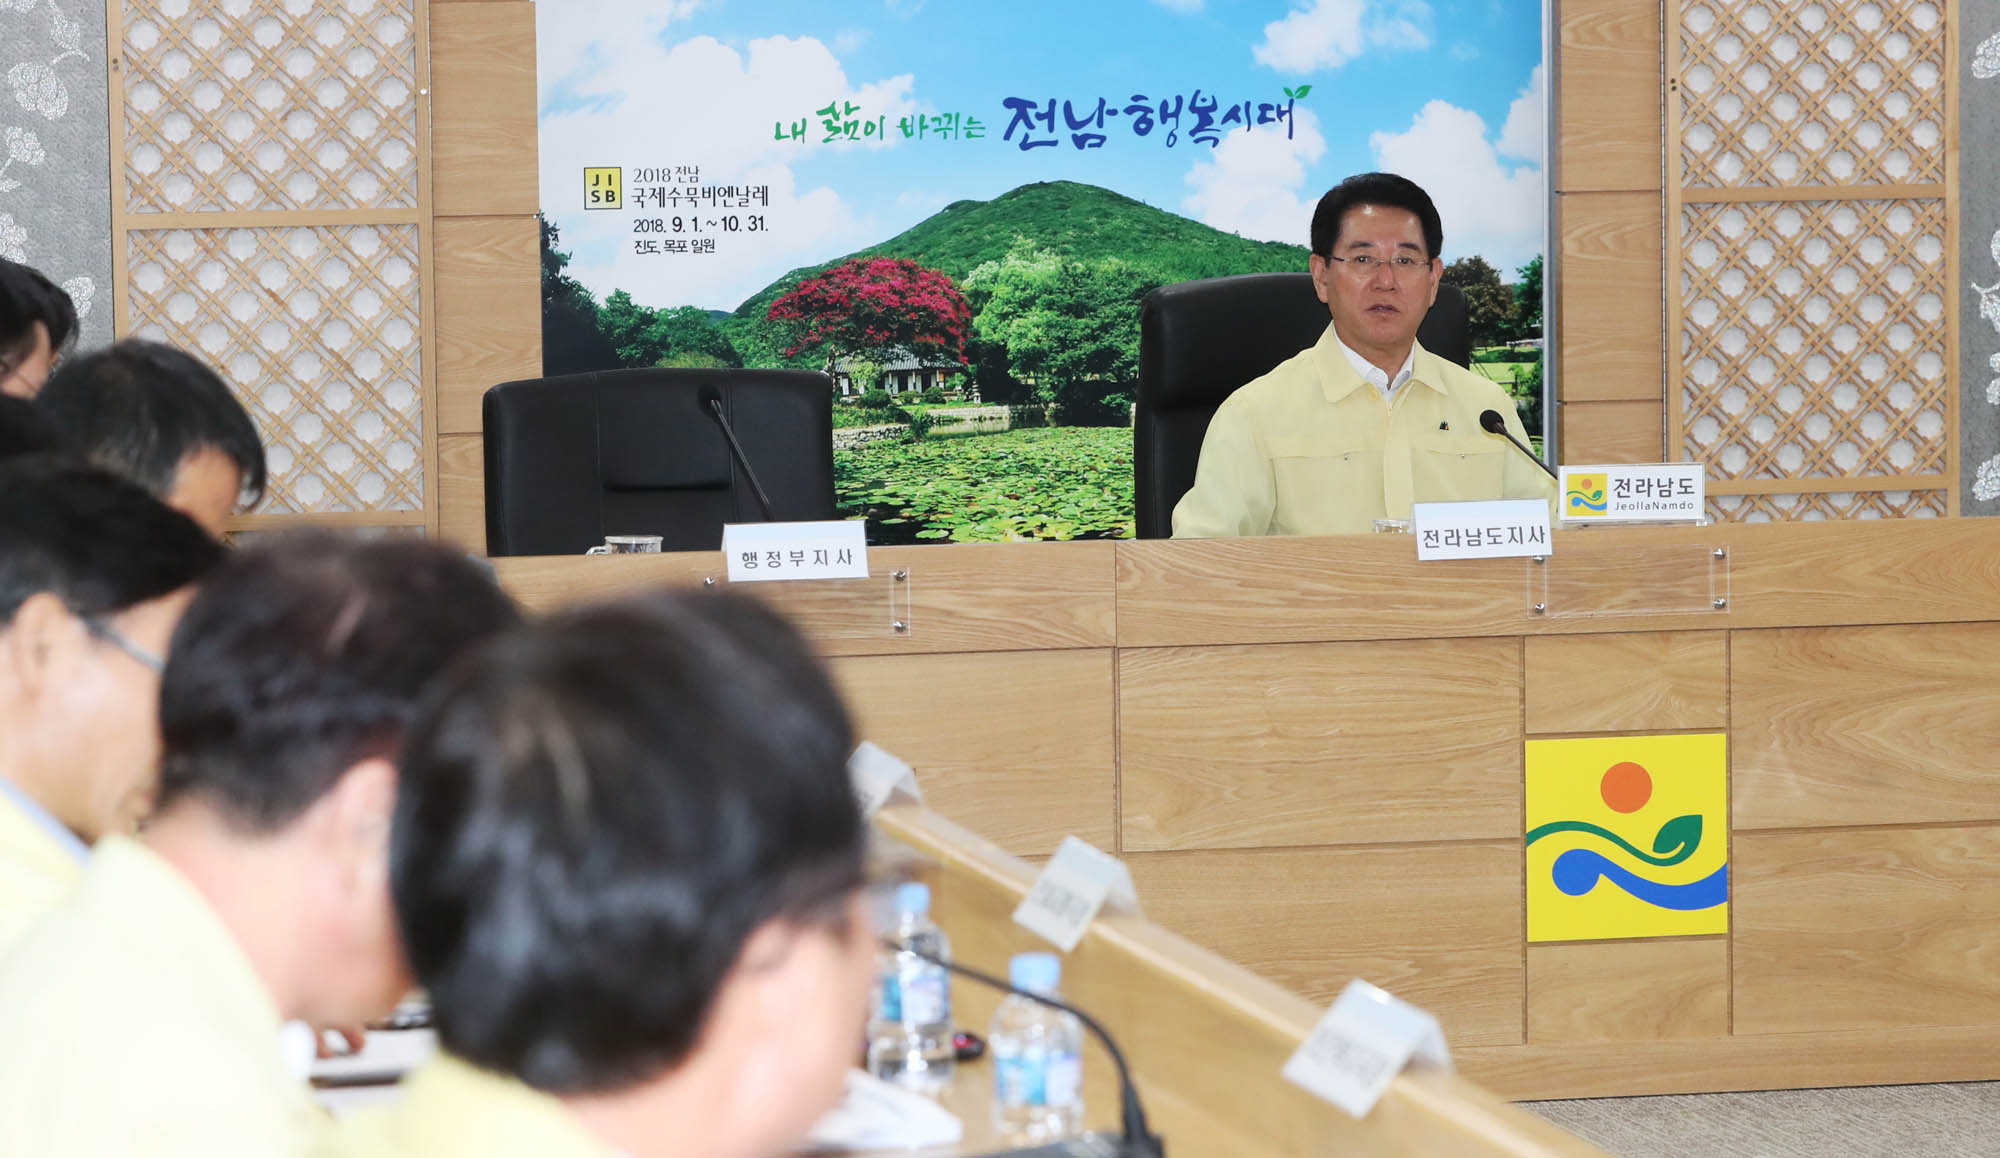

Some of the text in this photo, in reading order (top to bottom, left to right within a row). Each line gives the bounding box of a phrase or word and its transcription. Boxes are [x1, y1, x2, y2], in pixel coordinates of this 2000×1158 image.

[774, 117, 807, 145] 내
[896, 111, 987, 141] 바뀌는
[1002, 96, 1119, 151] 전남
[633, 165, 700, 183] 2018 전남
[631, 185, 769, 208] 국제수묵비엔날레
[633, 218, 667, 233] 2018.
[747, 215, 769, 232] 31.
[663, 239, 689, 255] 목포
[691, 238, 716, 254] 일원
[1613, 477, 1696, 498] 전라남도
[1614, 501, 1694, 511] JeollaNamdo
[1422, 525, 1546, 549] 전라남도지사
[741, 549, 853, 569] 행정부지사
